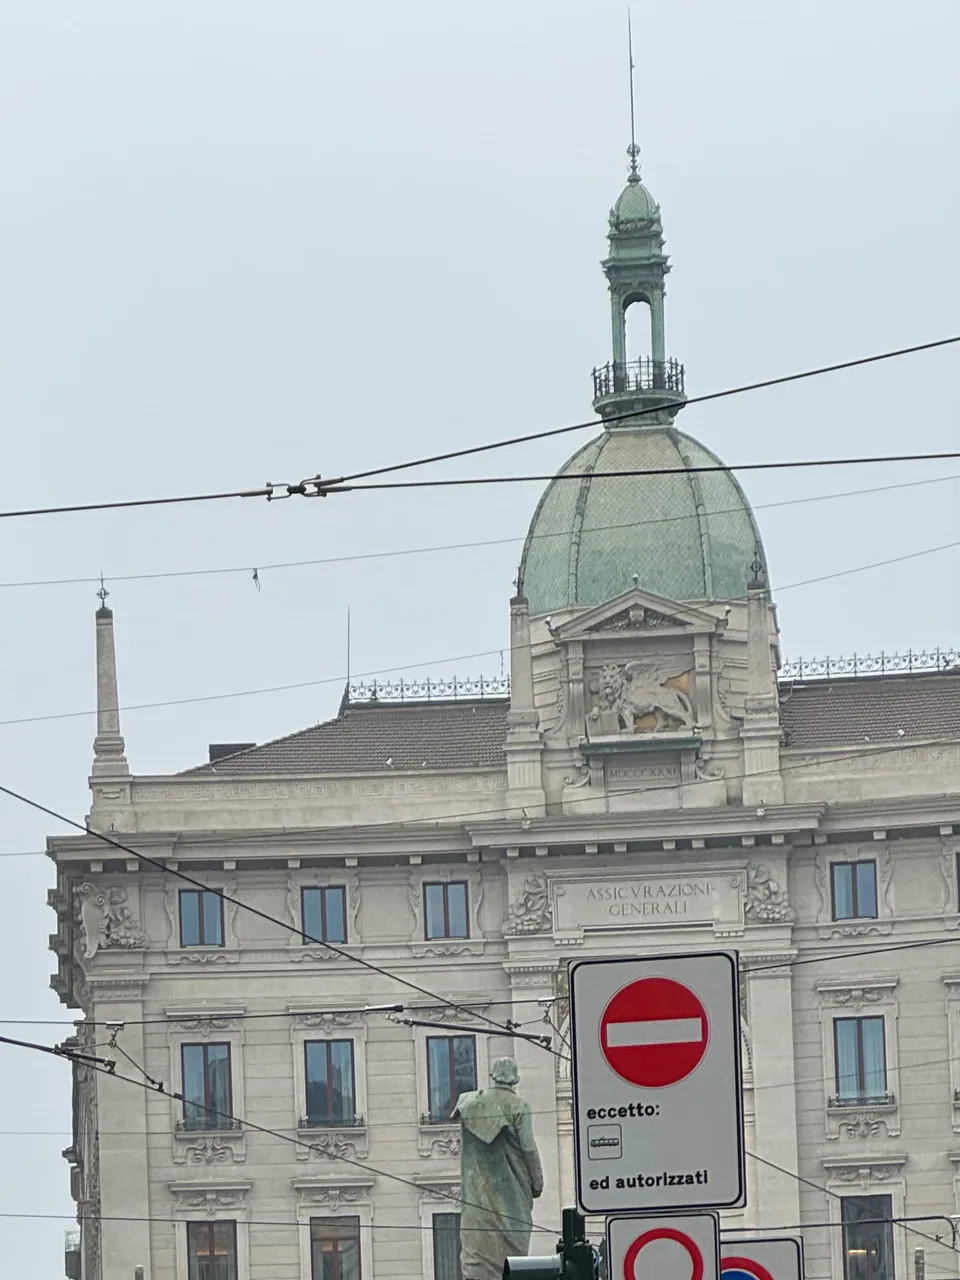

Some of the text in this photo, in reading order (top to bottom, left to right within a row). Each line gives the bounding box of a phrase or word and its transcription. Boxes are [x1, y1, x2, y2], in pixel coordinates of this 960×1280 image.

[609, 901, 687, 917] GENERALI
[586, 1102, 660, 1120] eccetto:
[589, 1169, 708, 1190] ed autorizzati
